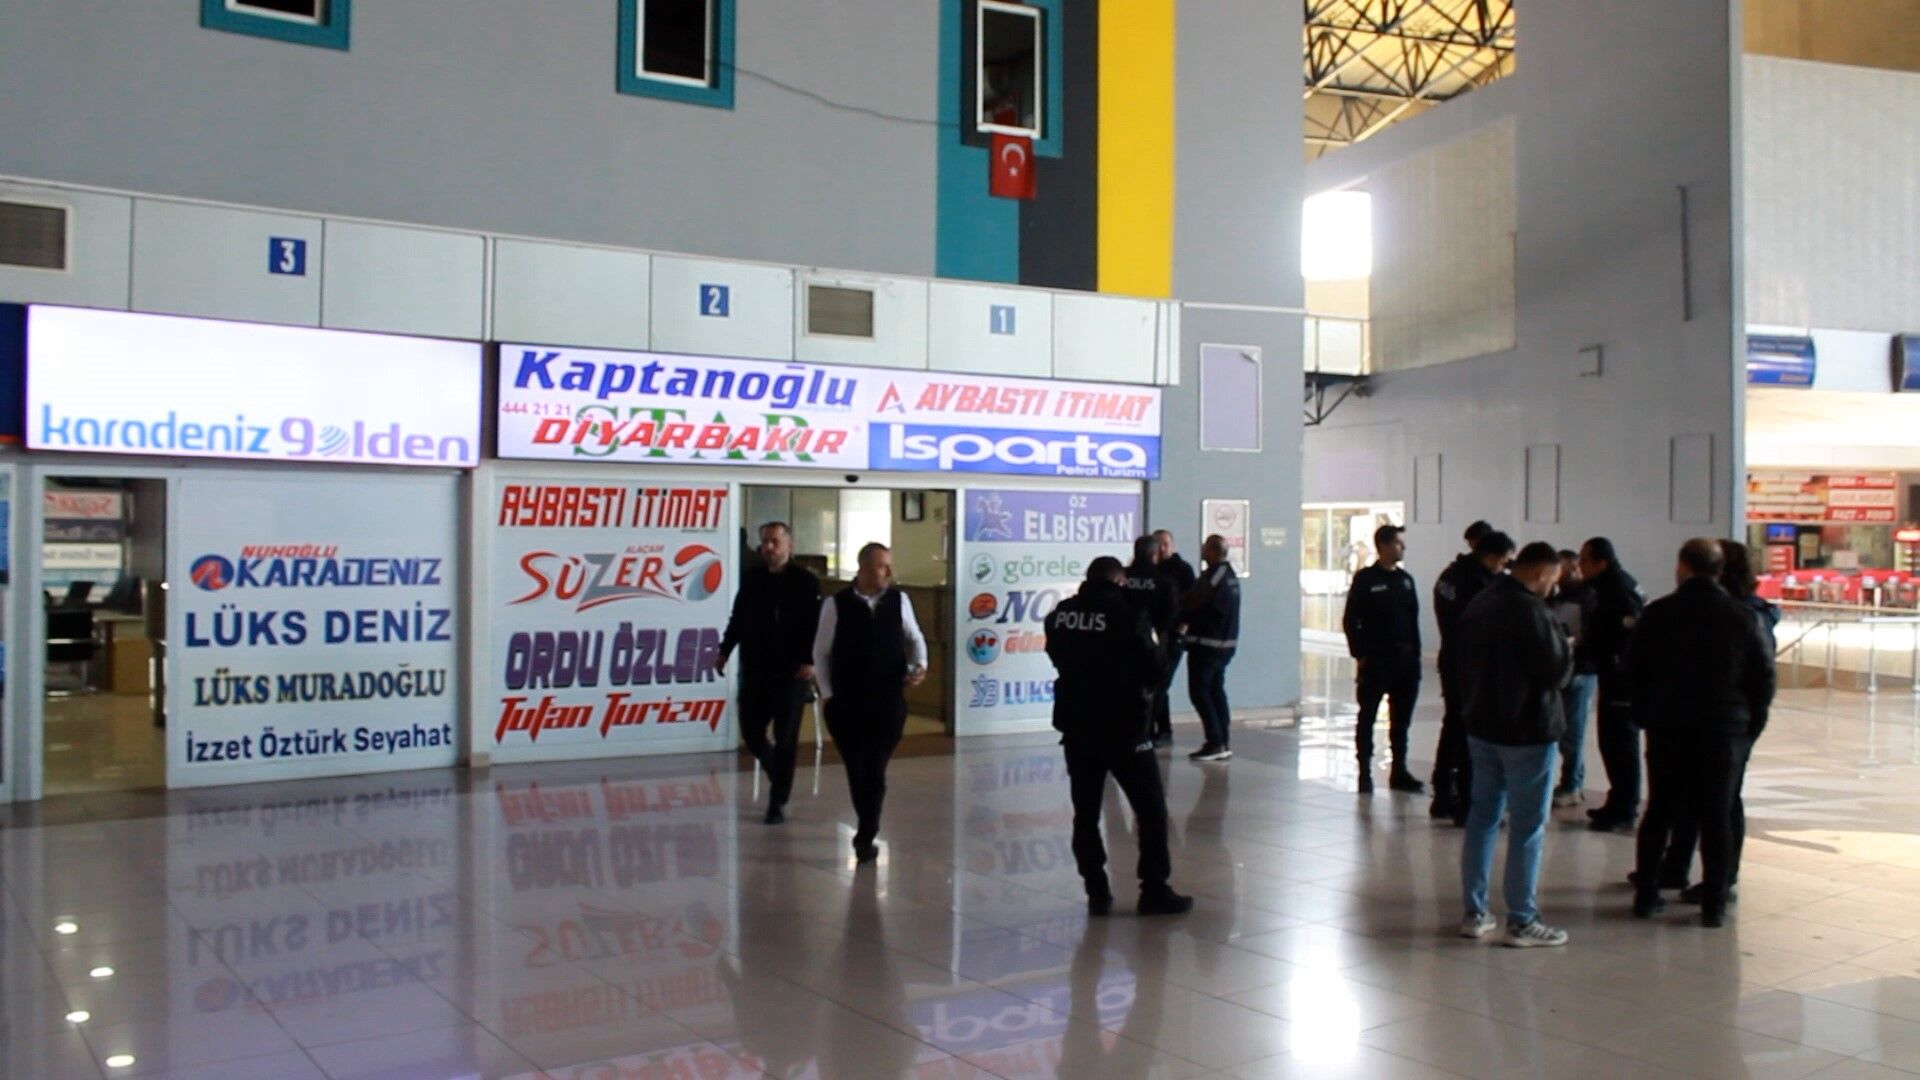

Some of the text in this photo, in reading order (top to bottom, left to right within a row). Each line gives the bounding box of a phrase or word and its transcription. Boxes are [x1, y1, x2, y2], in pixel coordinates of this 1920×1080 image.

[280, 240, 296, 272] 3
[708, 287, 721, 314] 2
[998, 309, 1009, 332] 1
[514, 350, 858, 409] Kaptanoğlu
[501, 402, 571, 416] 444 21 21
[914, 382, 1051, 416] AYBASTI
[41, 403, 271, 453] karadeniz
[889, 423, 1147, 470] Isparta
[1055, 464, 1147, 478] Petrol Turizm
[498, 485, 626, 528] AYBASTI
[1023, 508, 1134, 542] ELBİSTAN
[235, 556, 442, 588] KARADENİZ
[1002, 555, 1081, 585] görele
[185, 600, 452, 648] LÜKS DENİZ
[504, 620, 721, 690] ORDU ÖZLER
[194, 663, 447, 707] LÜKS MURADOĞLU
[494, 692, 728, 745] Tufan Turizm
[186, 722, 452, 763] İzzet Öztürk Seyahat
